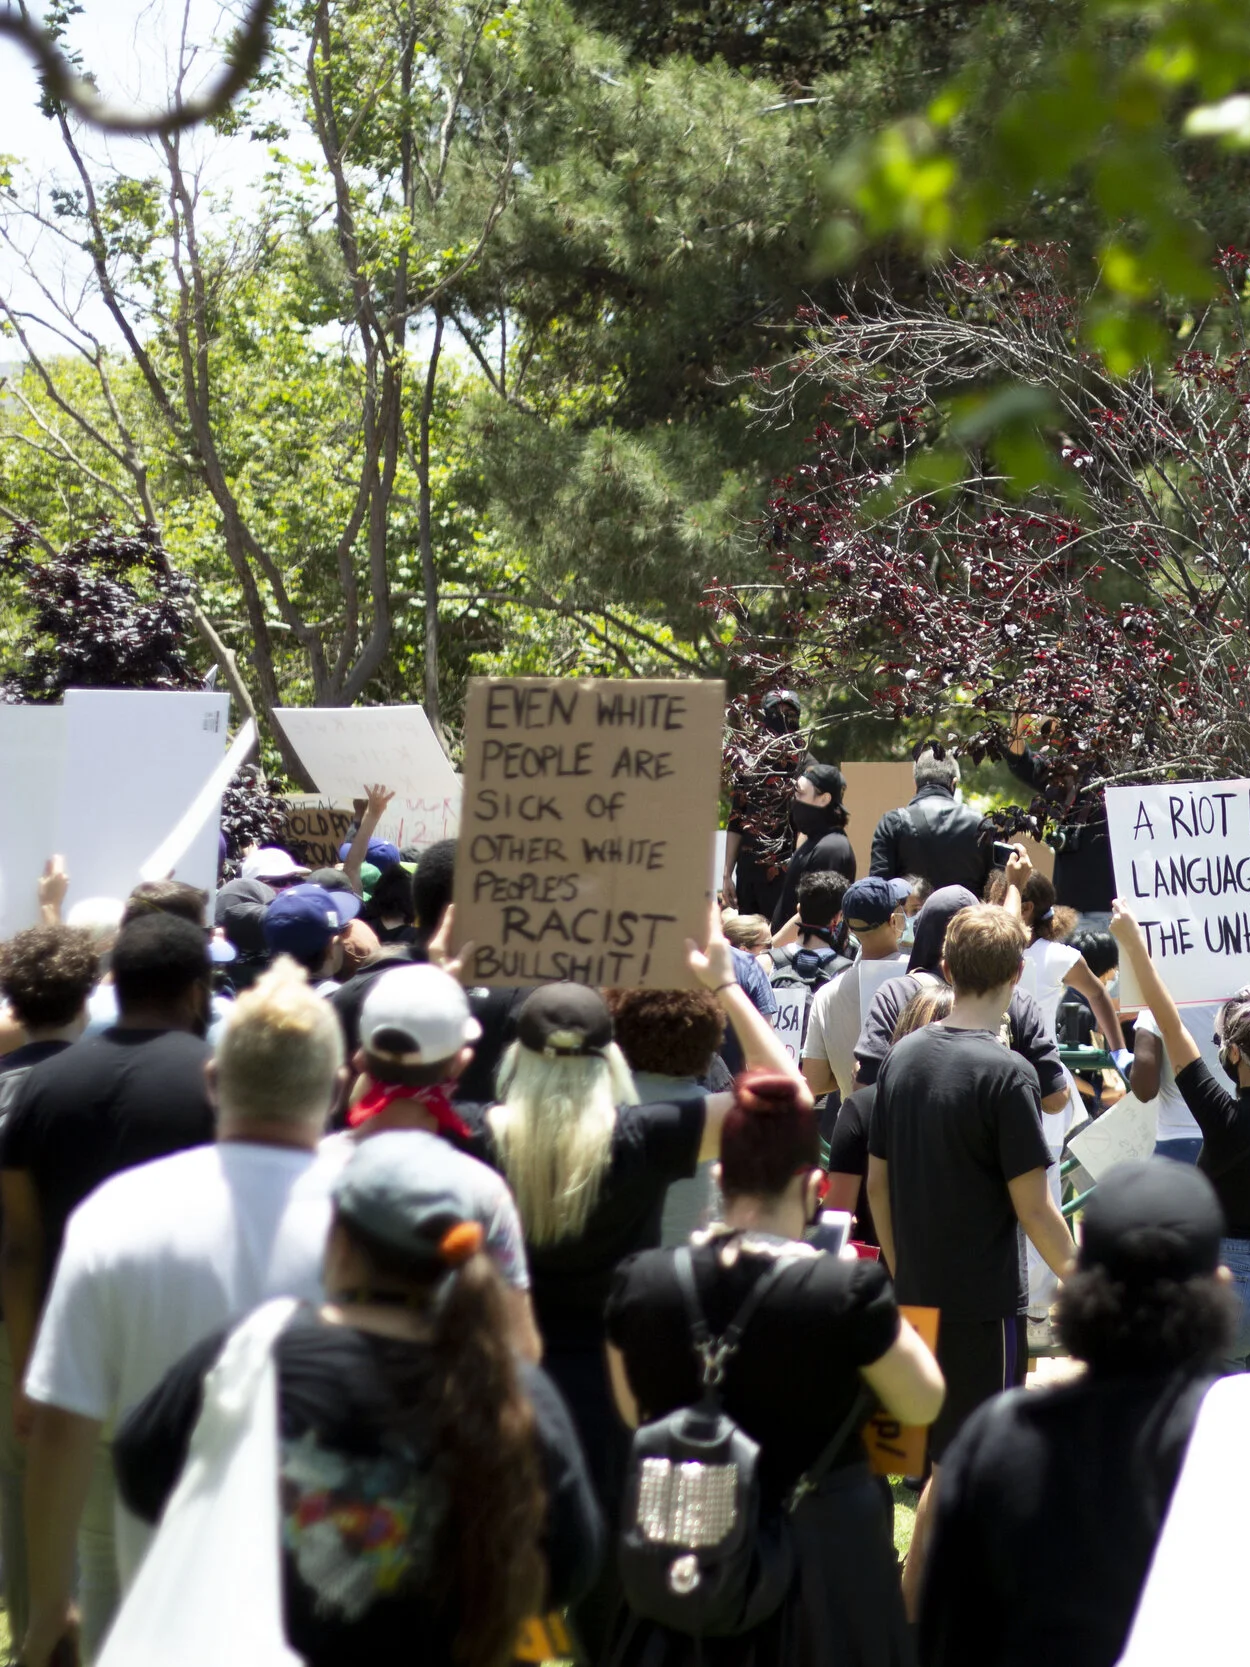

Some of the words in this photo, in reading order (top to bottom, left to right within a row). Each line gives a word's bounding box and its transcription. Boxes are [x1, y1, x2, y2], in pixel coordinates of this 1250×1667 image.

[486, 685, 578, 729] EVEN
[596, 693, 687, 730] WHITE
[480, 740, 594, 781] PEOPLE
[611, 747, 676, 781] ARE
[474, 789, 563, 821] SICK
[1133, 800, 1154, 840] A
[1169, 791, 1237, 839] RIOT
[470, 834, 567, 865] OTHER
[582, 837, 667, 870] WHITE
[501, 905, 677, 949] RACIST
[1138, 919, 1194, 958] THE
[473, 946, 650, 985] BULLSHIT!
